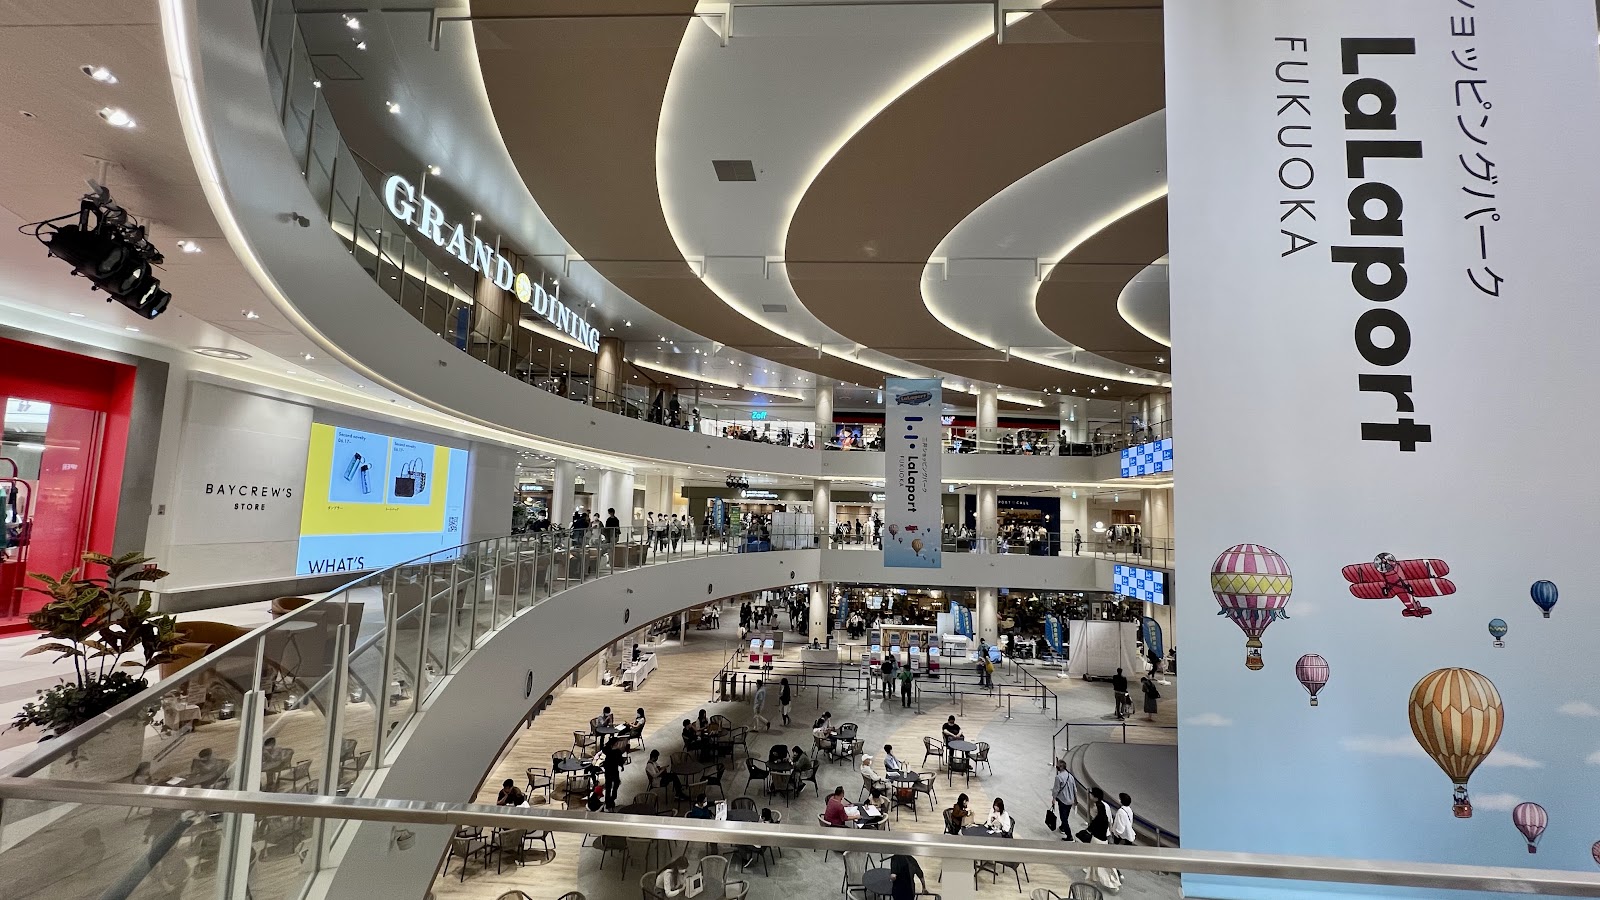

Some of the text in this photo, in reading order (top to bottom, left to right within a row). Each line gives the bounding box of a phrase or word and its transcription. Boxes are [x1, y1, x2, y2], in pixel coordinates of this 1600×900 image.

[1274, 36, 1318, 258] FUKUOKA
[1330, 37, 1432, 452] LaLaport
[384, 174, 600, 354] GRAND DINING
[751, 411, 767, 419] Zoff
[205, 483, 292, 498] BAYCREW'S
[905, 456, 919, 513] LaLaport
[234, 503, 266, 511] STORE
[308, 556, 364, 574] WHAT'S
